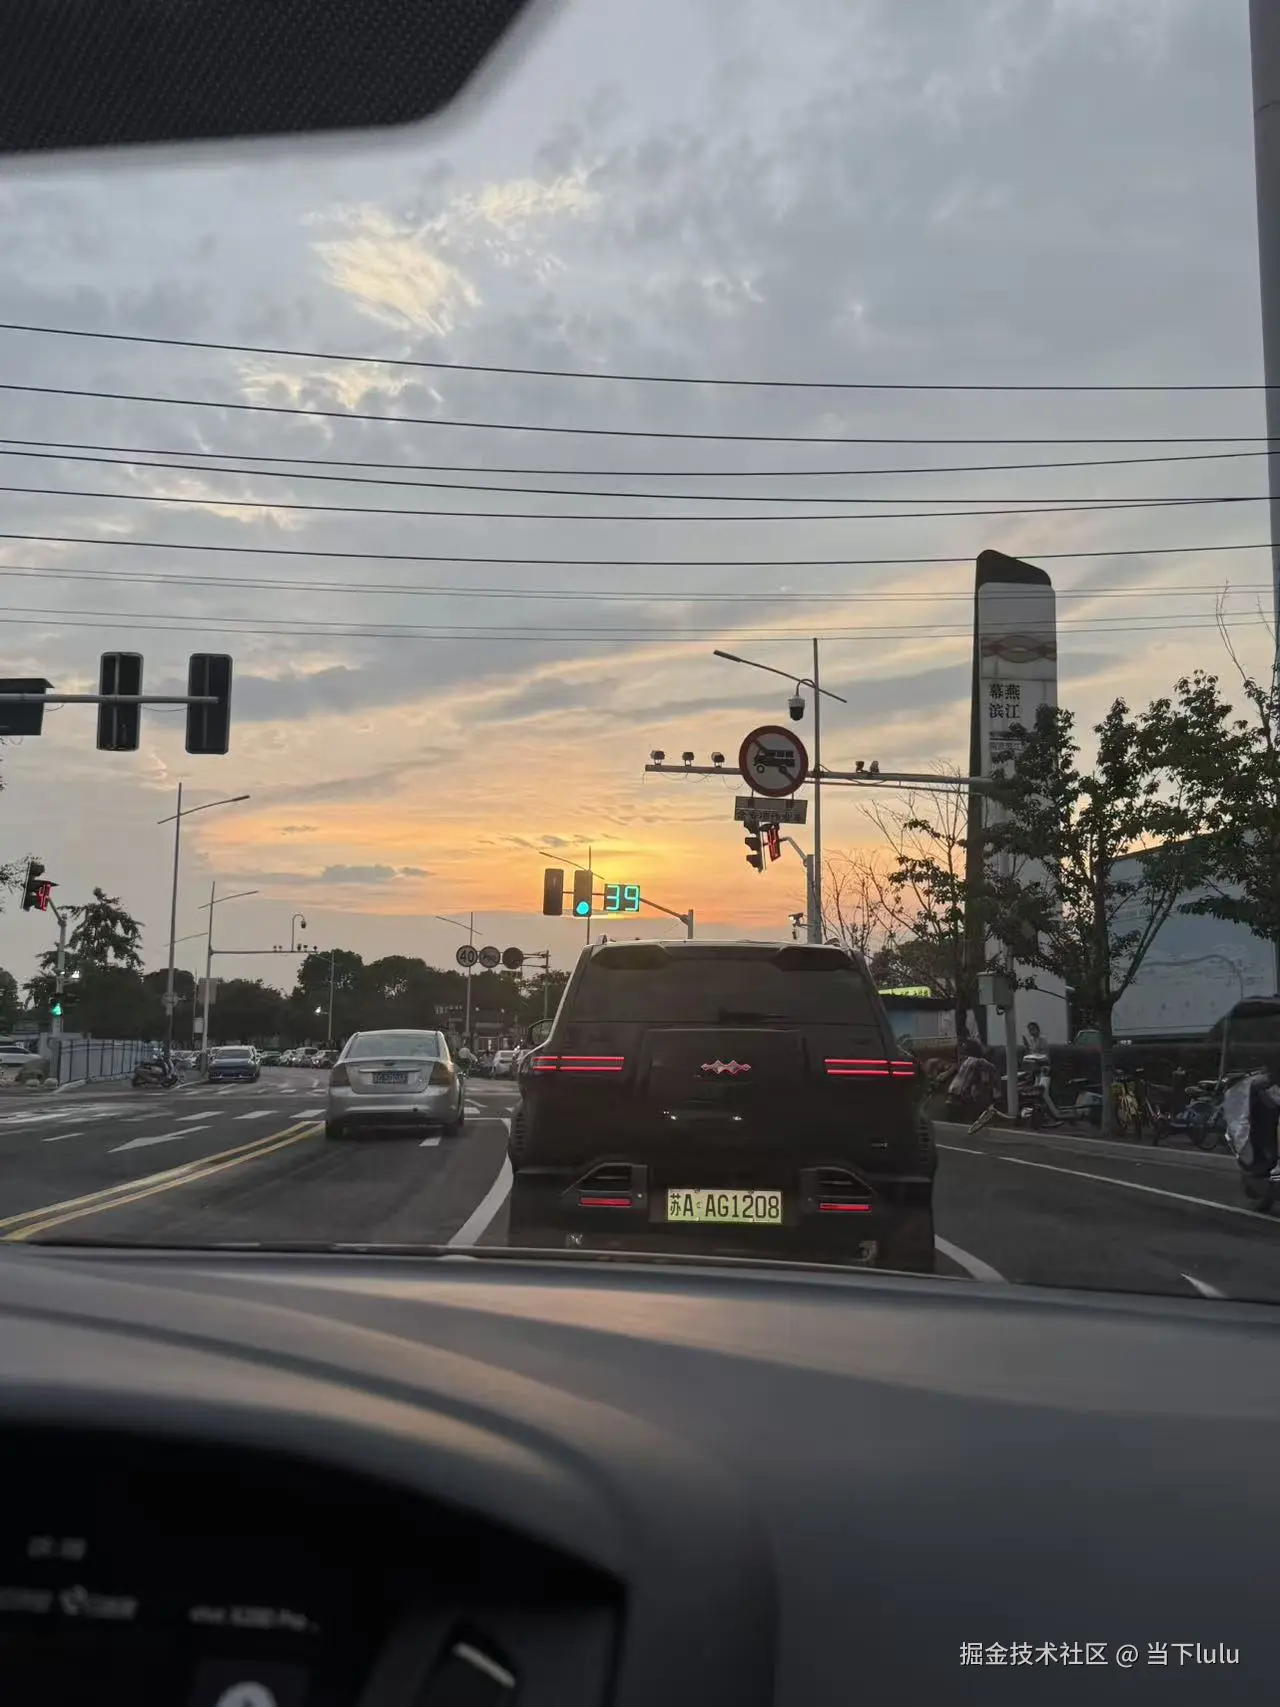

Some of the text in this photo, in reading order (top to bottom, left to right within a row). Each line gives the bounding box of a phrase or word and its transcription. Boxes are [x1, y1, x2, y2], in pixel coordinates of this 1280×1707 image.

[989, 702, 1020, 719] 滨江
[606, 884, 639, 911] 39
[460, 950, 475, 963] 40
